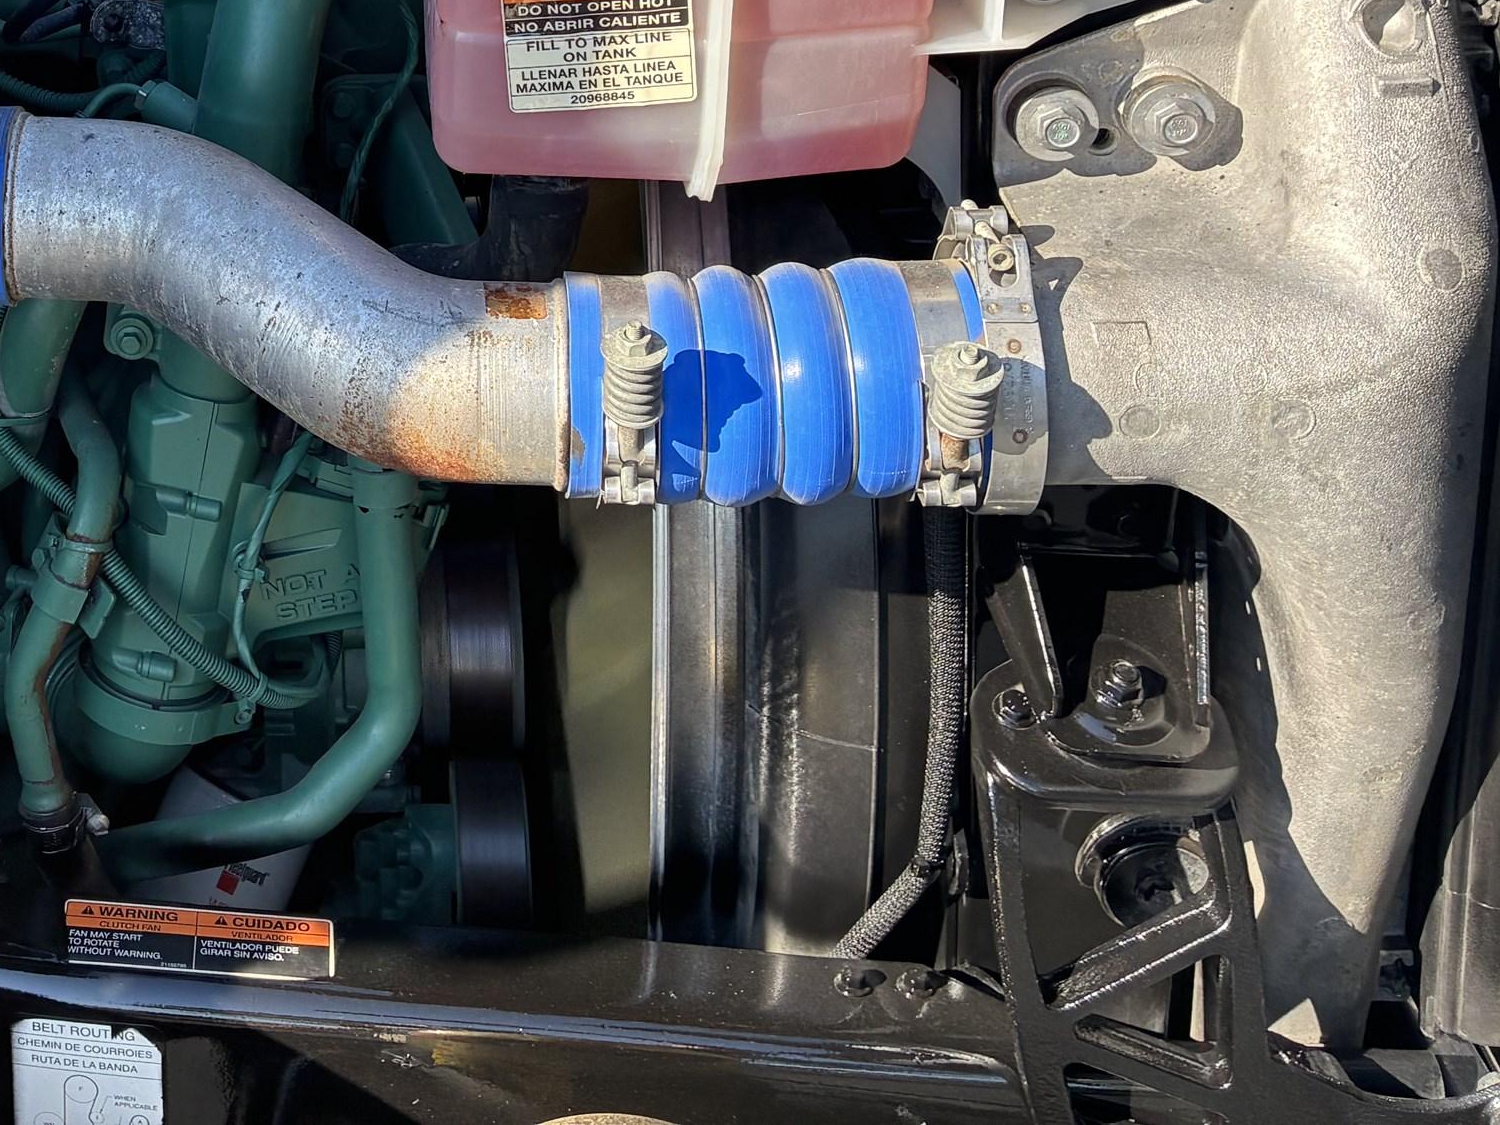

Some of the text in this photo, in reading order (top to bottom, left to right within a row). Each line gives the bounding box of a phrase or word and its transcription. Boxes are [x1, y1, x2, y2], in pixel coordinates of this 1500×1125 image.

[517, 3, 542, 17] DO
[547, 2, 582, 15] NOT
[587, 0, 634, 12] OPEN
[514, 12, 681, 33] NO ABRIR CALIENTE
[526, 31, 672, 52] FILL TO MAX LINE
[563, 47, 637, 63] ON TANK
[521, 61, 677, 82] LLENAR HASTA LINEA
[516, 72, 684, 95] MAXIMA EN EL TANQUE
[570, 91, 635, 105] 20968845
[261, 568, 327, 600] NOT
[276, 588, 358, 619] STEP
[99, 906, 179, 922] WARNING
[100, 920, 162, 932] CLUTCH FAN
[232, 917, 310, 932] CUIDADO
[68, 937, 120, 948] TO ROTATE
[69, 929, 143, 942] FAN MAY START
[231, 931, 293, 942] VENTILADOR
[67, 945, 163, 960] WITHOUT WARNING.
[200, 939, 300, 955] VENTILADOR PUEDE
[200, 947, 285, 962] GIRAR SIN AVISO.
[32, 1021, 136, 1042] BELT ROUTNG
[17, 1036, 153, 1059] CHEMIN DE COURROIES
[31, 1054, 138, 1074] RUTA DE LA BANDA
[114, 1094, 137, 1103] WHEN
[114, 1102, 159, 1112] APPLICABLE
